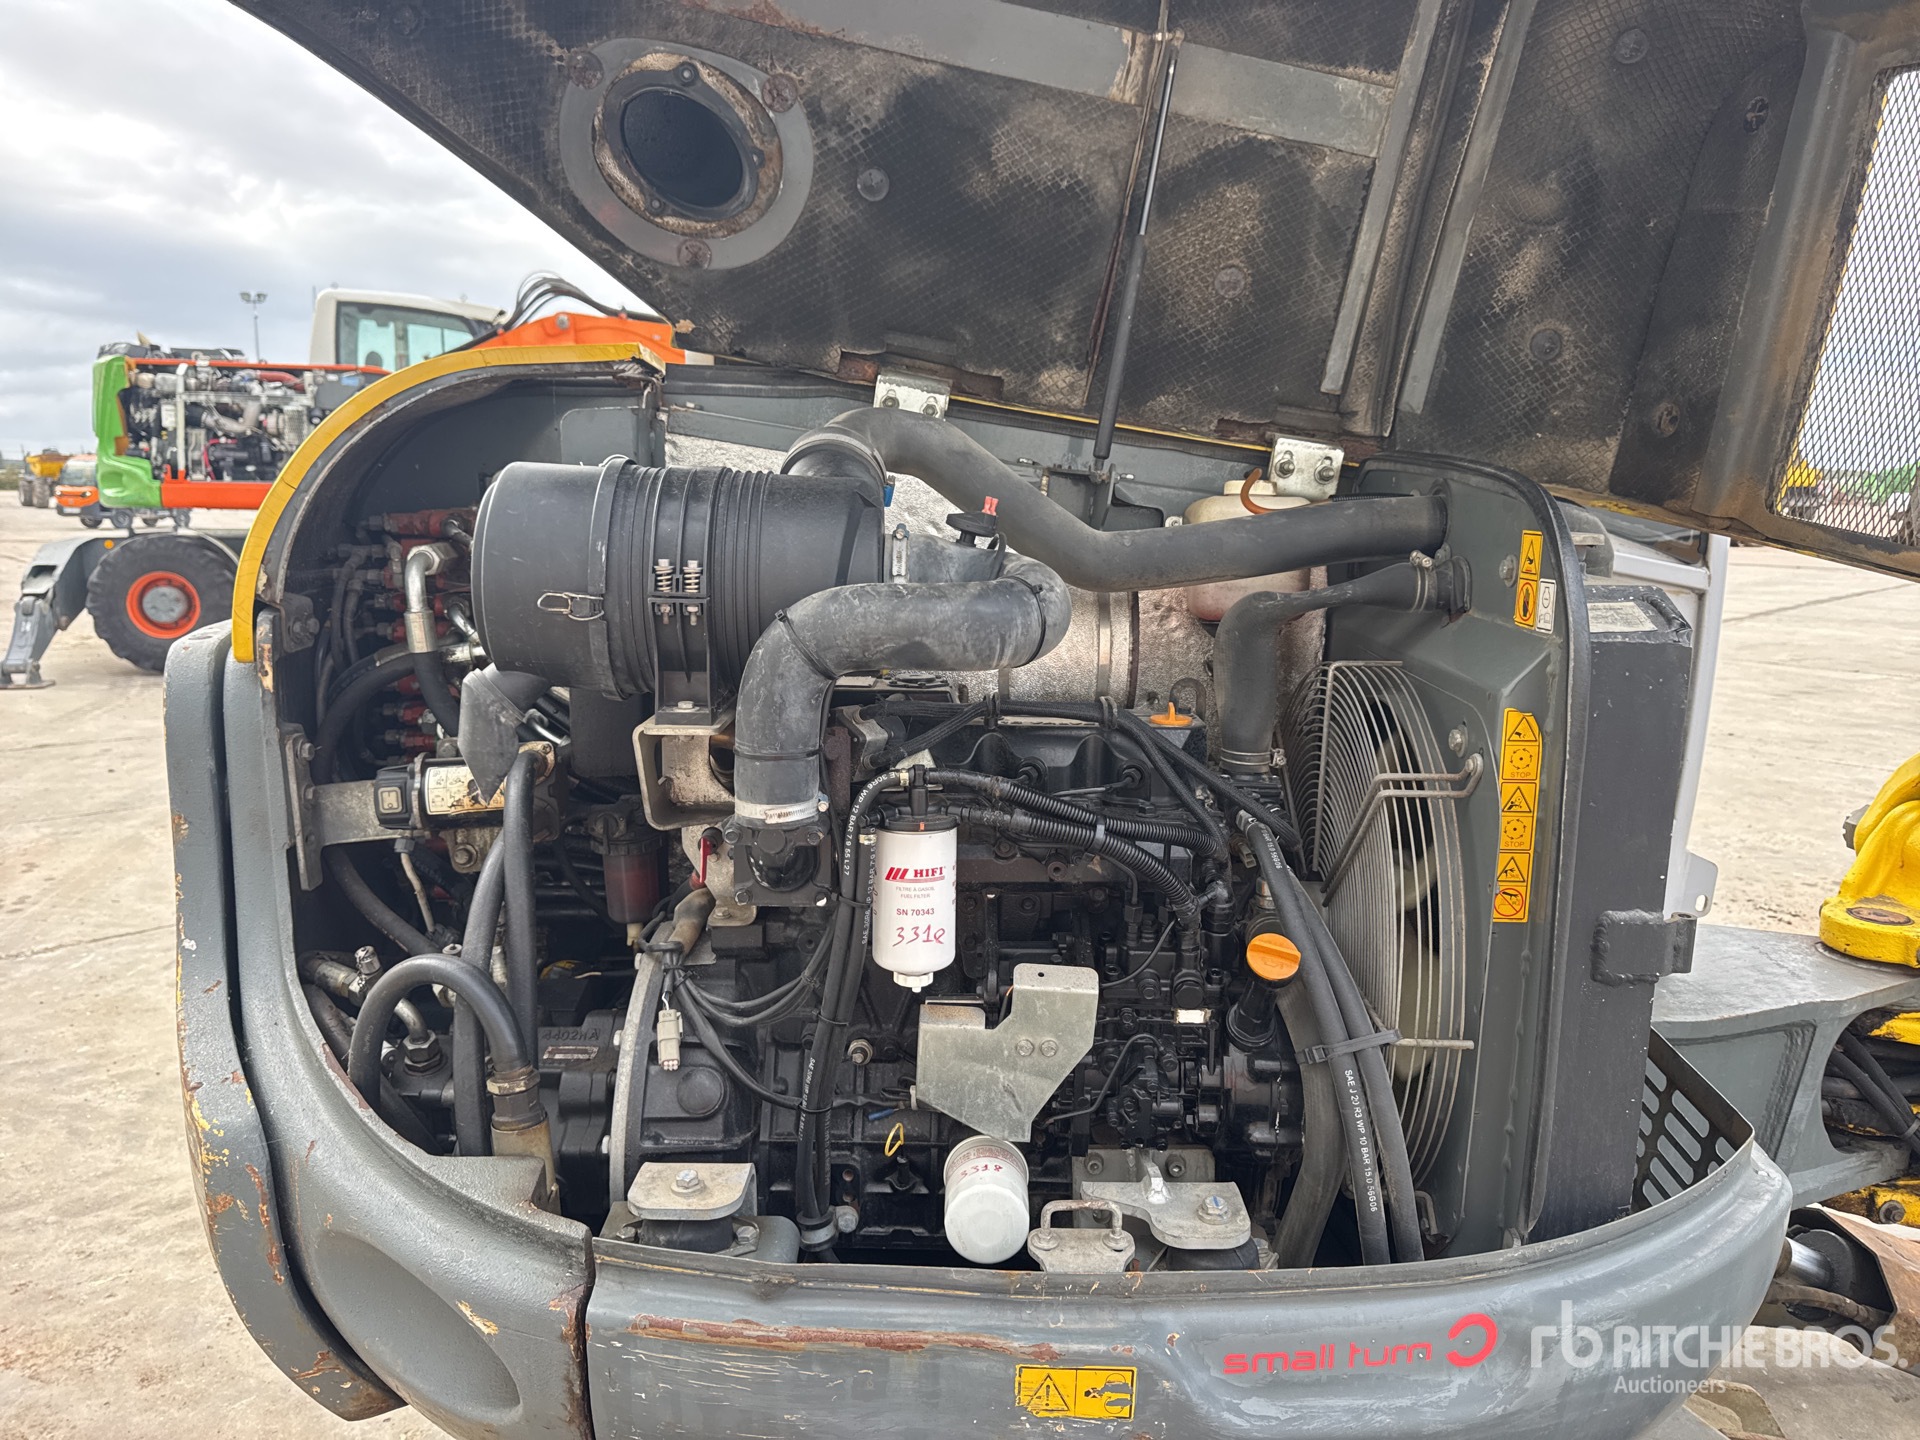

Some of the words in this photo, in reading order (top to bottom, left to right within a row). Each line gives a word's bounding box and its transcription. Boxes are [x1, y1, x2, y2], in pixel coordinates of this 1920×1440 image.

[858, 789, 869, 803] WP
[852, 804, 859, 814] 12
[847, 815, 856, 832] BAR
[914, 867, 943, 877] HIFI
[911, 908, 934, 916] 70343
[1345, 1070, 1355, 1086] SAE
[1354, 1106, 1361, 1118] R3
[1356, 1119, 1365, 1134] WP
[1360, 1136, 1367, 1144] 10
[1361, 1147, 1370, 1165] BAR
[1223, 1344, 1335, 1374] small
[1348, 1342, 1432, 1368] turn
